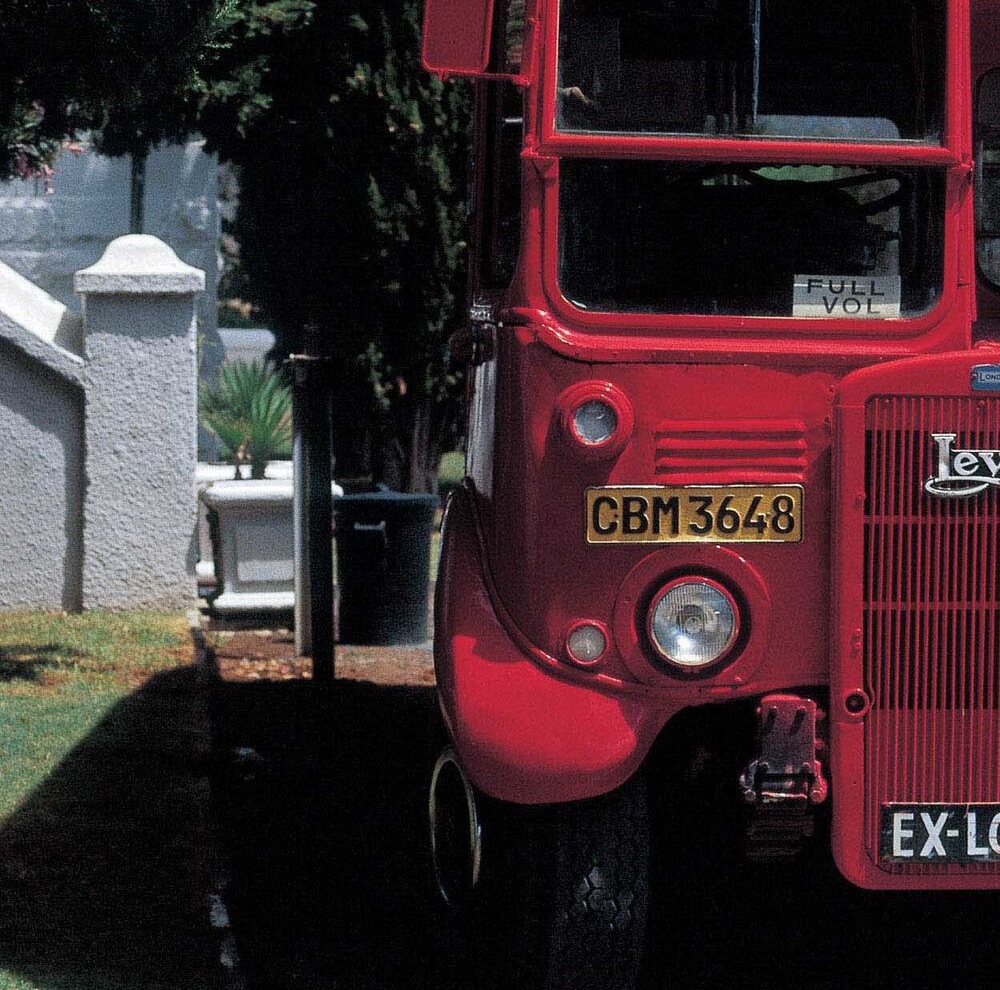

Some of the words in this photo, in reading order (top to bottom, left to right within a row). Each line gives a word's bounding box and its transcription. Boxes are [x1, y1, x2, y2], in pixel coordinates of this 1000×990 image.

[806, 278, 885, 297] FULL
[822, 296, 881, 315] VOL
[592, 495, 680, 535] CBM
[688, 495, 795, 535] 3648
